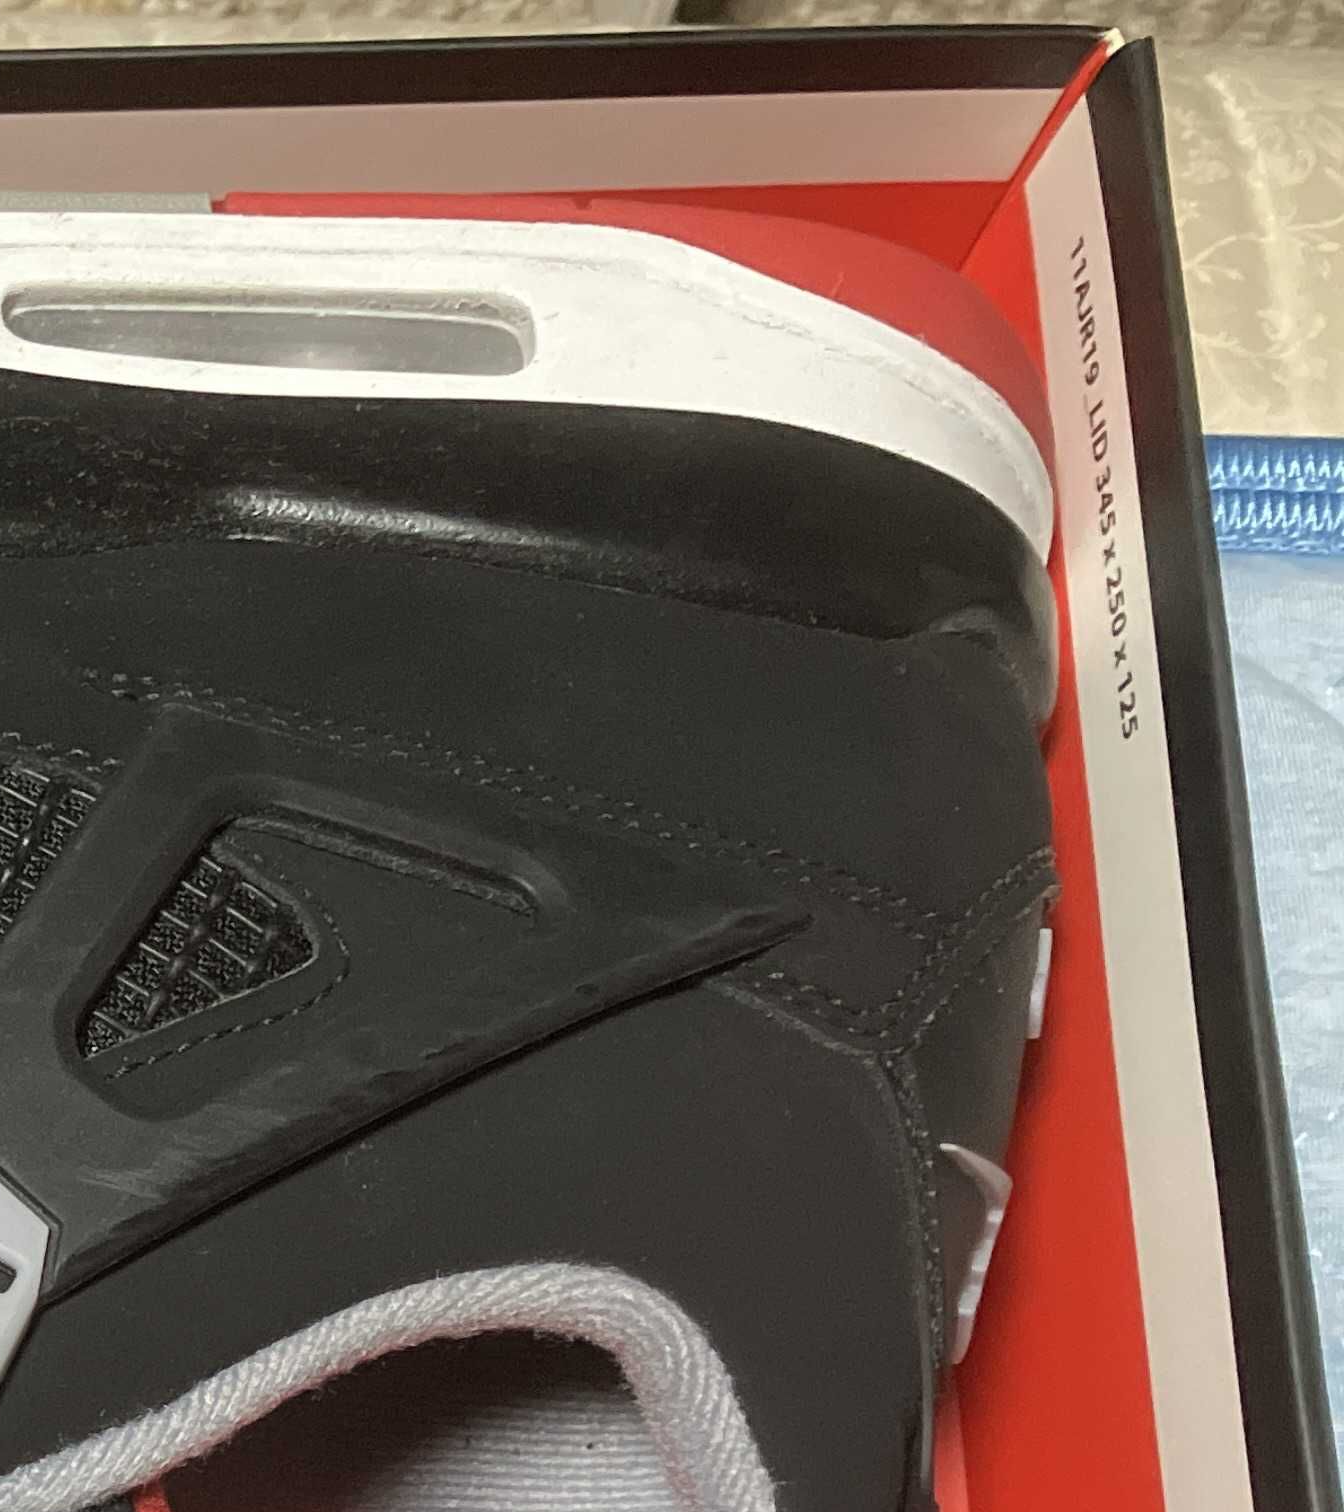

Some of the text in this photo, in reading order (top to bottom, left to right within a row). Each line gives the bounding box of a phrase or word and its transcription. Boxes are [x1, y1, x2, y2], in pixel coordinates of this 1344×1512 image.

[1095, 466, 1116, 536] 345
[1102, 539, 1115, 566] x
[1106, 566, 1127, 637] 250
[1113, 641, 1126, 668] x
[1118, 671, 1138, 739] 125
